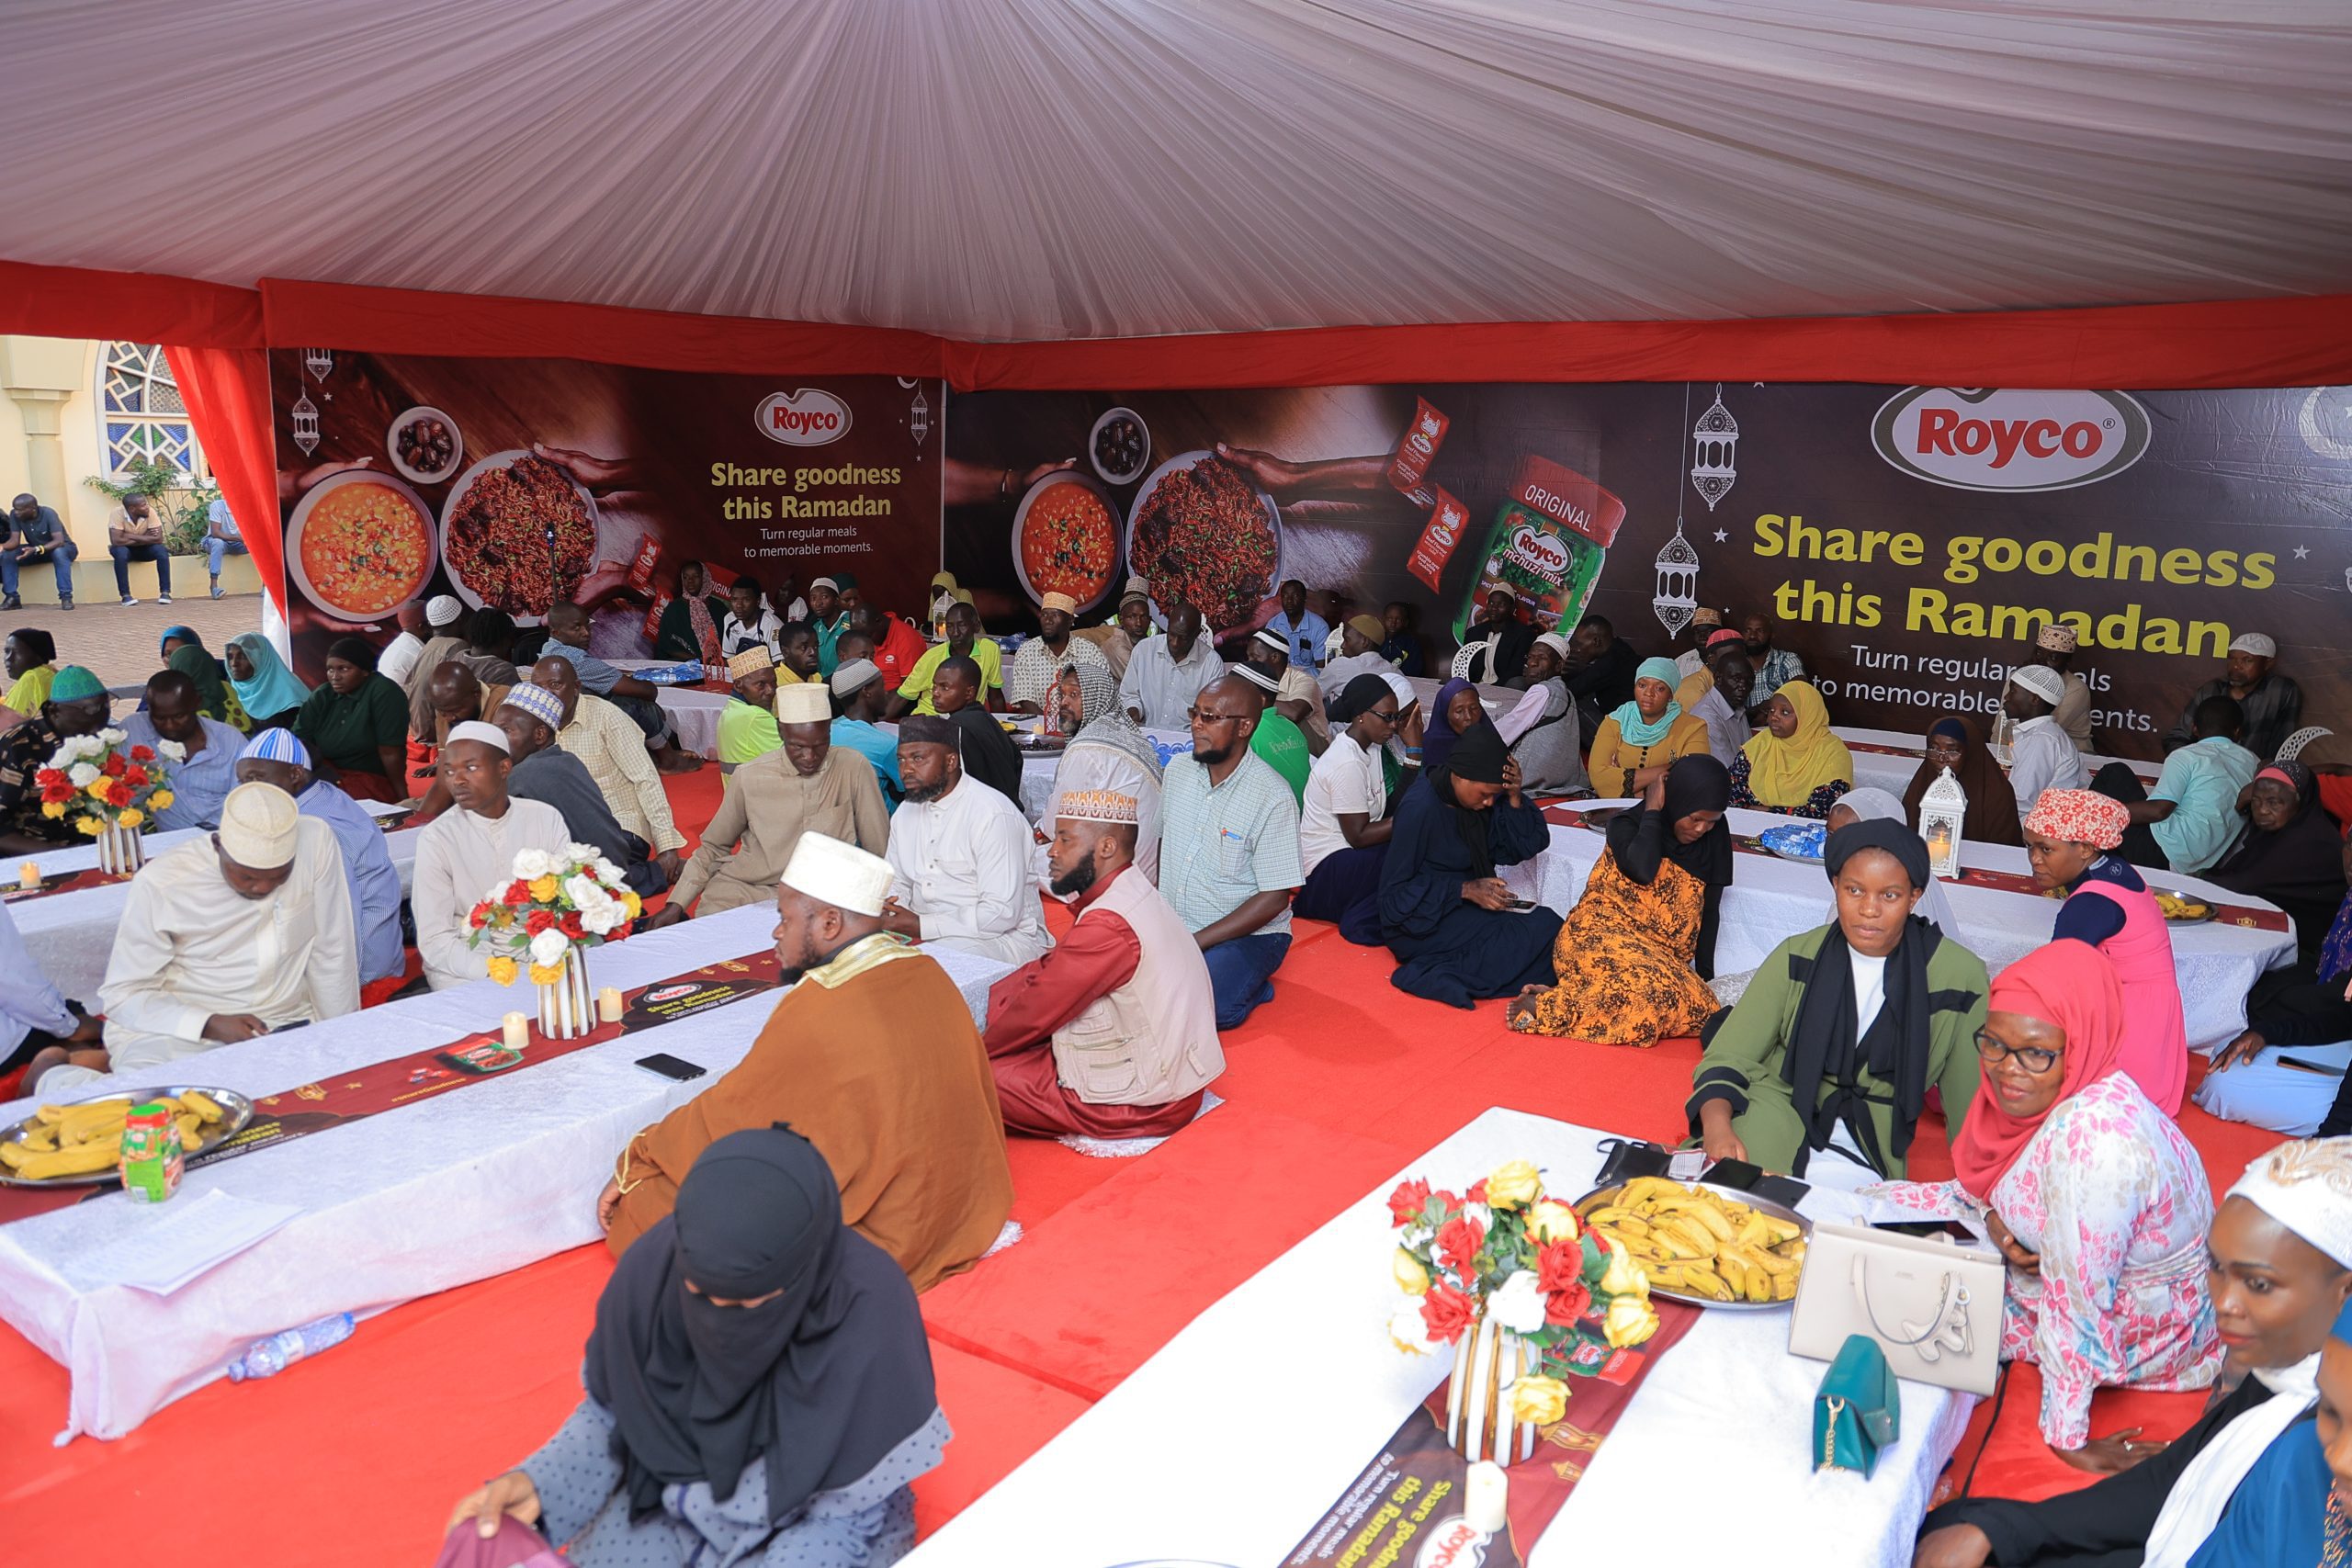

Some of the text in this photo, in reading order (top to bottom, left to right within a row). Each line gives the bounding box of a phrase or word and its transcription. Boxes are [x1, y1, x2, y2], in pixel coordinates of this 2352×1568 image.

[773, 406, 838, 435] Royco
[711, 462, 901, 492] Share goodness
[722, 494, 891, 520] this Ramadan
[1525, 484, 1591, 533] ORIGINAL
[744, 541, 874, 558] to memorable moments.
[760, 525, 857, 542] Turn regular meals
[1434, 528, 1450, 544] Royco
[1518, 533, 1563, 567] Royco
[1753, 513, 2276, 590] Share goodness
[1503, 548, 1564, 587] mchuzi mix
[1773, 580, 2231, 659] this Ramadan
[1850, 645, 2017, 682] Turn regular
[1813, 675, 2000, 716] to memorable
[1410, 1480, 1452, 1522] Share
[1336, 1475, 1422, 1568] this Ramadan
[1428, 1524, 1477, 1568] Royc
